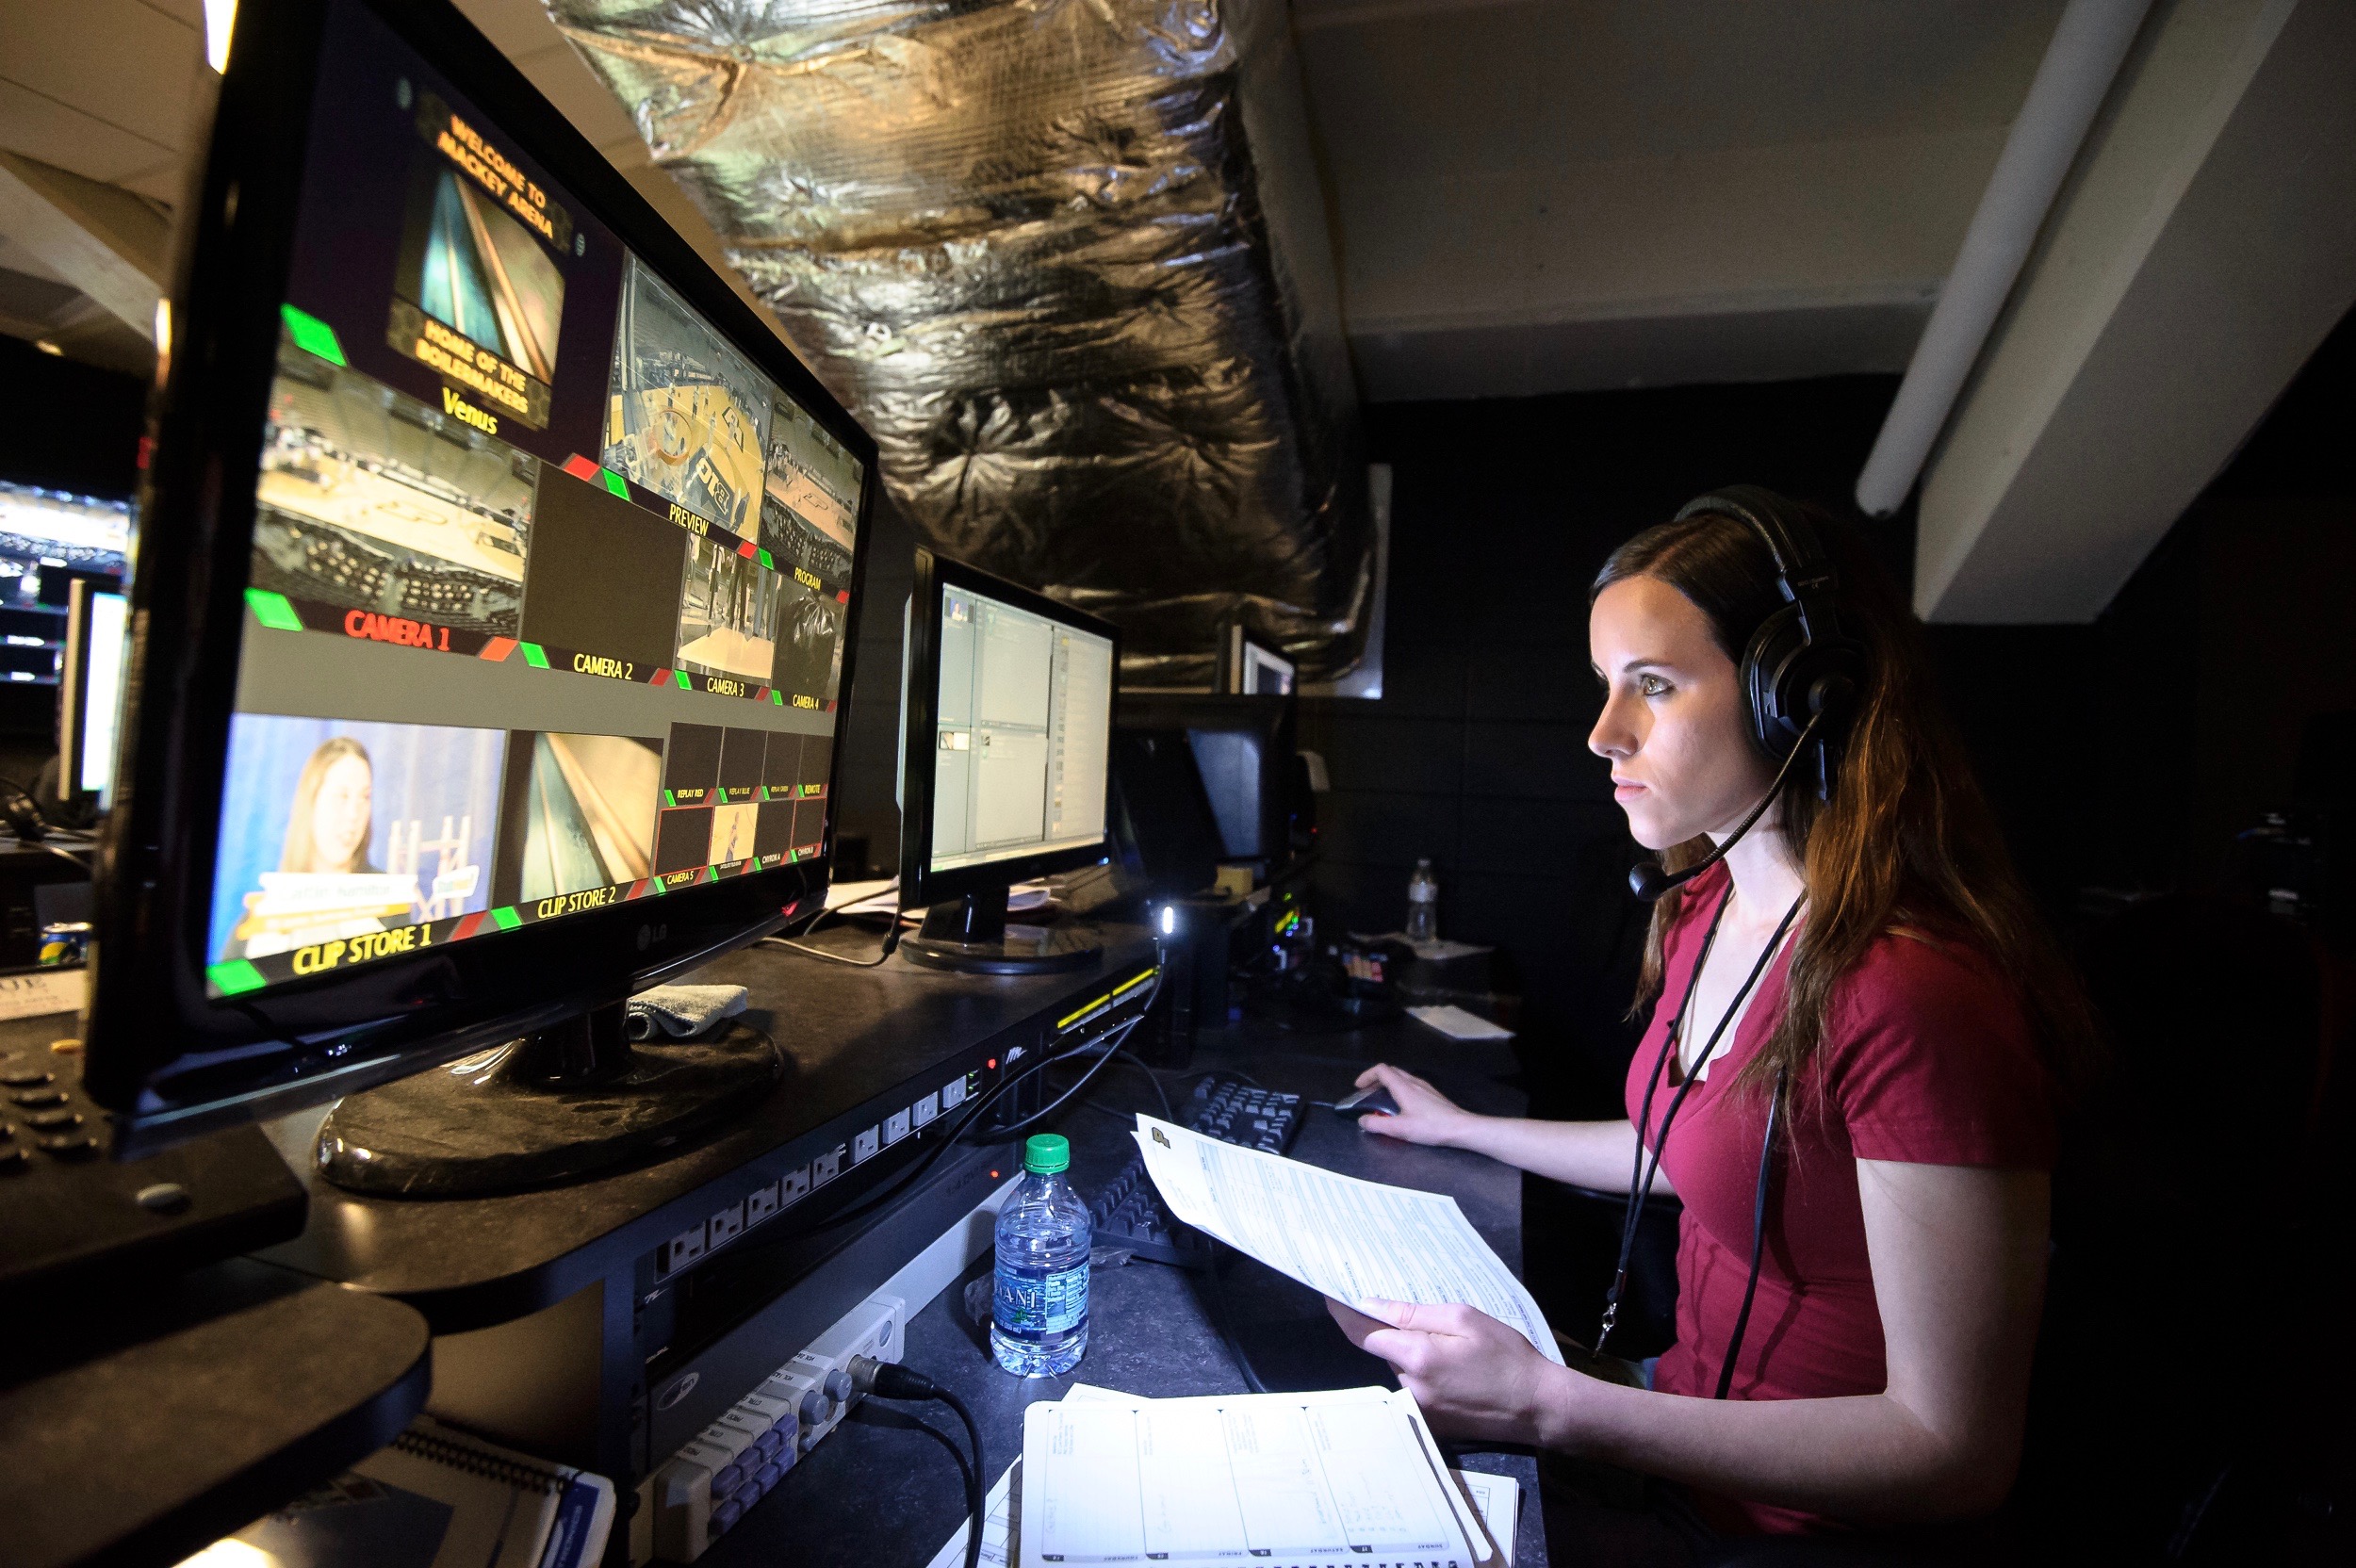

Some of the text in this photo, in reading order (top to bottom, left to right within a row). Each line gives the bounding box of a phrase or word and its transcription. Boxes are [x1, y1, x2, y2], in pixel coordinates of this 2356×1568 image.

[450, 114, 547, 209] WELCOME TO
[437, 130, 554, 239] MACKEY ARENA
[424, 319, 527, 391] HOME OF THE
[415, 336, 529, 415] BOILERMAKERS
[442, 386, 498, 435] Venus
[669, 503, 709, 536] PREVIEW
[794, 566, 821, 591] PROGRAM
[344, 610, 450, 652] CAMERA 1
[573, 653, 633, 680] CAMERA 2
[707, 677, 744, 697] CAMERA 3
[793, 694, 819, 710] CAMERA 4
[677, 788, 704, 799] REPLAY RED
[805, 784, 821, 794] REMOTE
[667, 871, 695, 885] CAMERA 5
[537, 886, 616, 920] CLIP STORE 2
[292, 923, 432, 975] CLIP STORE 1
